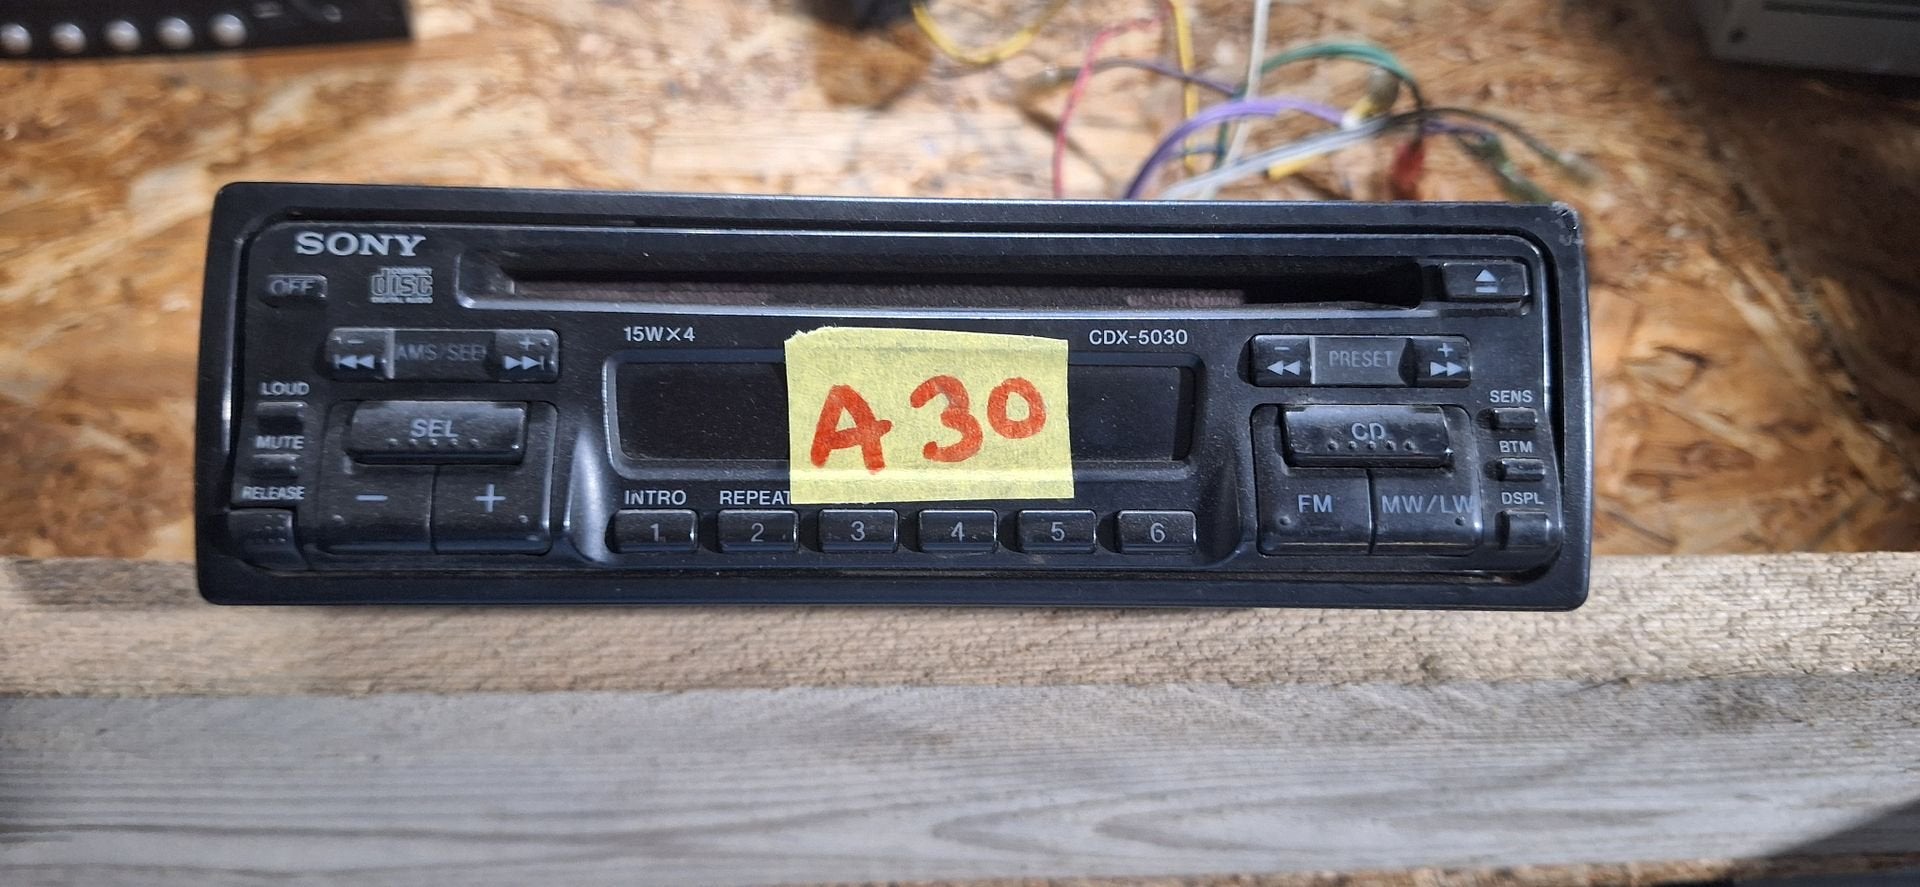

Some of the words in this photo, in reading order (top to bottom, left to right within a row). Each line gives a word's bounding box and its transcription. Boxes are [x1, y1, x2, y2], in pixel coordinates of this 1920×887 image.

[295, 231, 426, 257] SONY
[270, 278, 315, 295] OFF
[1089, 329, 1188, 345] CDX-5030
[1329, 350, 1393, 367] PRESET
[261, 381, 310, 396] LOUD
[1489, 390, 1533, 403] SENS
[410, 419, 458, 438] SEL
[1352, 422, 1386, 441] CD
[255, 435, 304, 449] MUTE
[1499, 440, 1533, 453] BTM
[242, 486, 305, 500] RELEASE
[624, 490, 687, 505] INTRO
[1501, 492, 1544, 505] DSPL
[1298, 495, 1333, 513] FM
[1381, 494, 1474, 514] MW/LW
[650, 523, 660, 541] 1
[750, 522, 765, 542] 2
[850, 520, 866, 541] 3
[951, 521, 965, 542] 4
[1050, 521, 1065, 542] 5
[1150, 522, 1165, 543] 6
